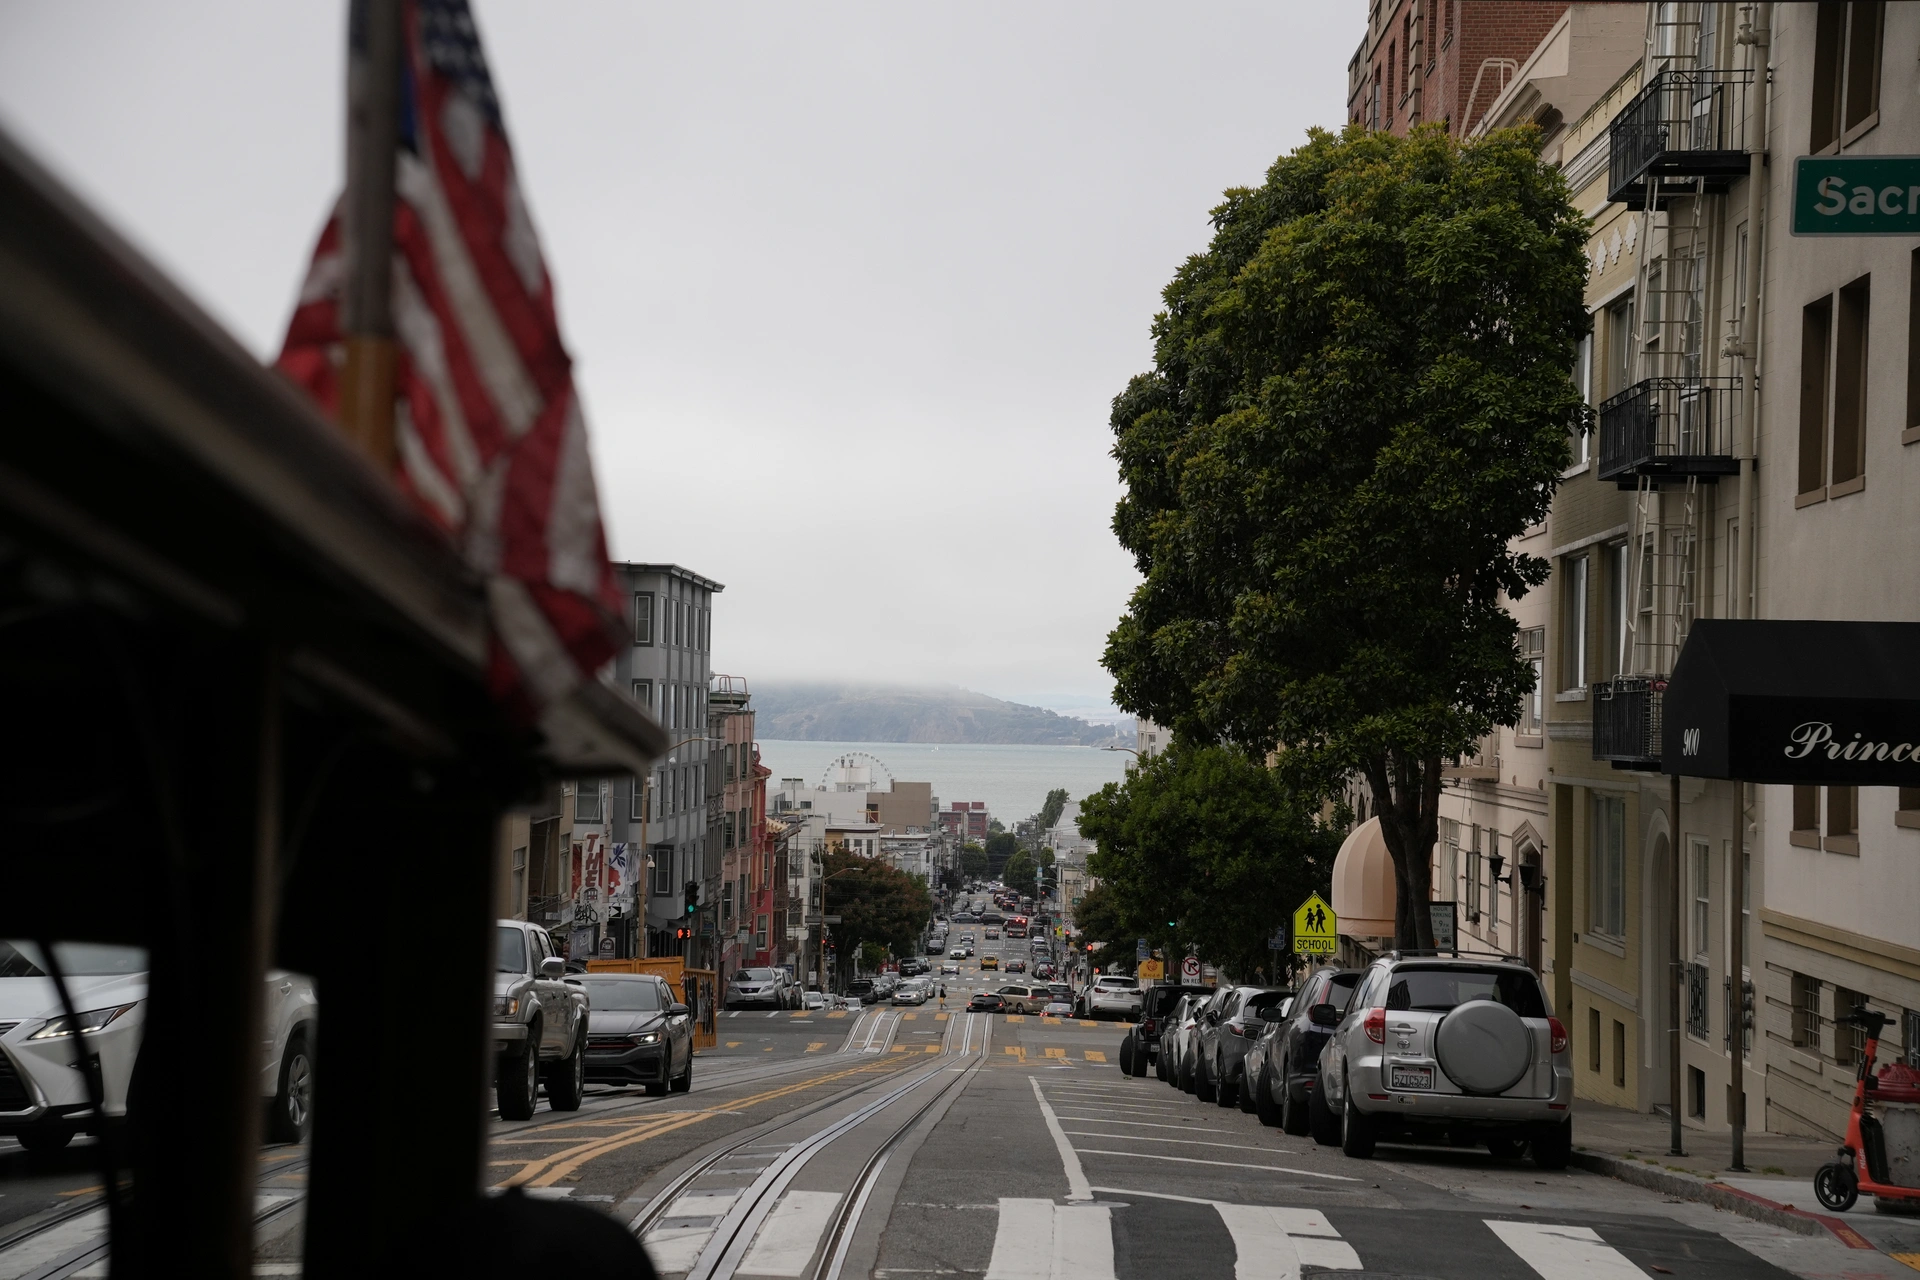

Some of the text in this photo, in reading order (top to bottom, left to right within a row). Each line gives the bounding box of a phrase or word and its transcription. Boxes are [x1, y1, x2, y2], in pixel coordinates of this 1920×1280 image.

[1813, 176, 1920, 216] Sacr
[1682, 728, 1701, 757] 900
[1296, 939, 1334, 950] SCHOOL
